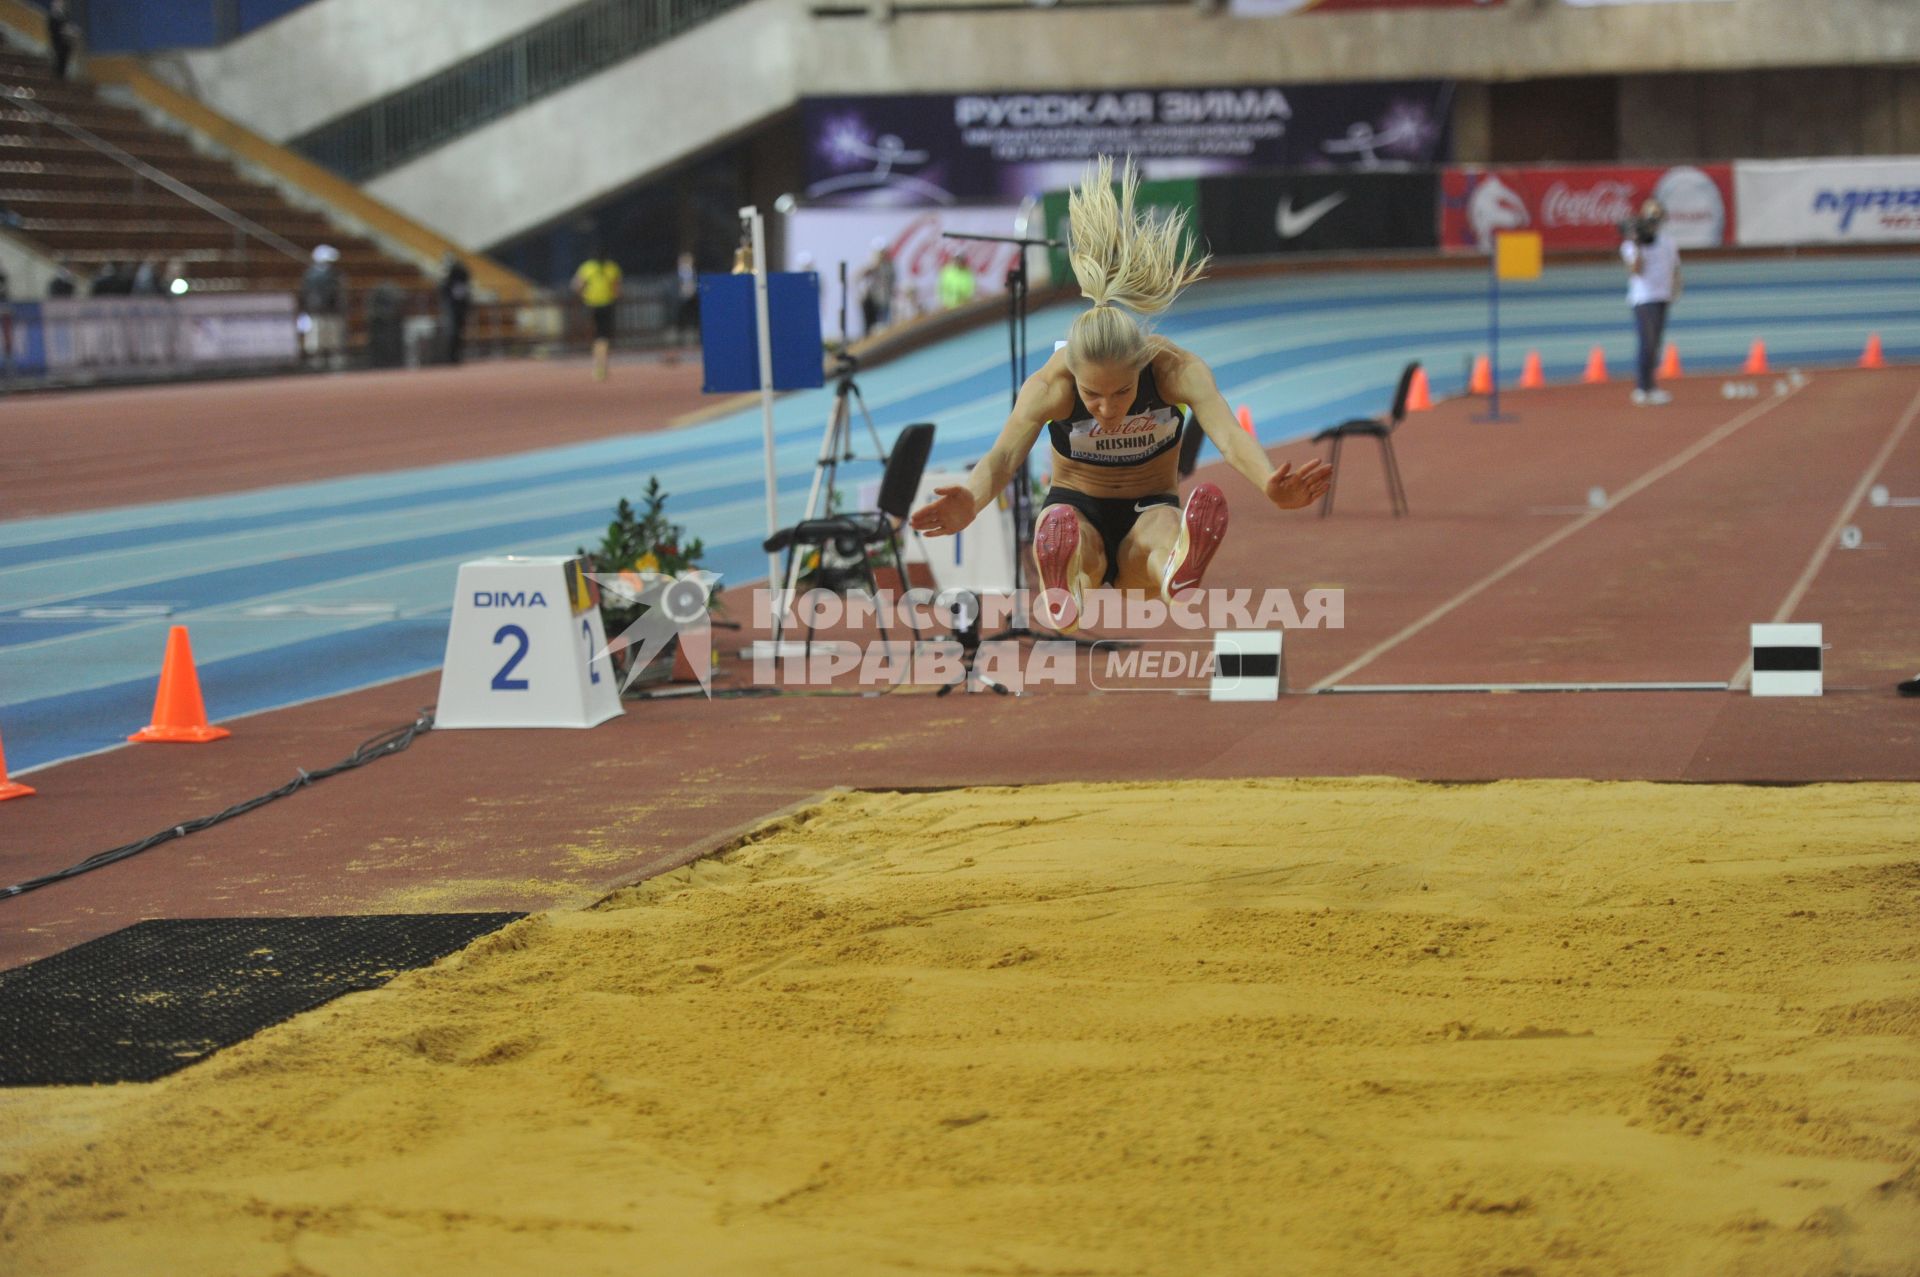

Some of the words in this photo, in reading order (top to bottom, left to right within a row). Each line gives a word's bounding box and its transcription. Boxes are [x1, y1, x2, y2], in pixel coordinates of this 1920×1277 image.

[954, 93, 1153, 128] РУССКАЯ
[1159, 88, 1292, 123] ЗИМА
[1096, 433, 1156, 451] KLISHINA
[473, 592, 547, 608] DIMA
[491, 624, 530, 690] 2
